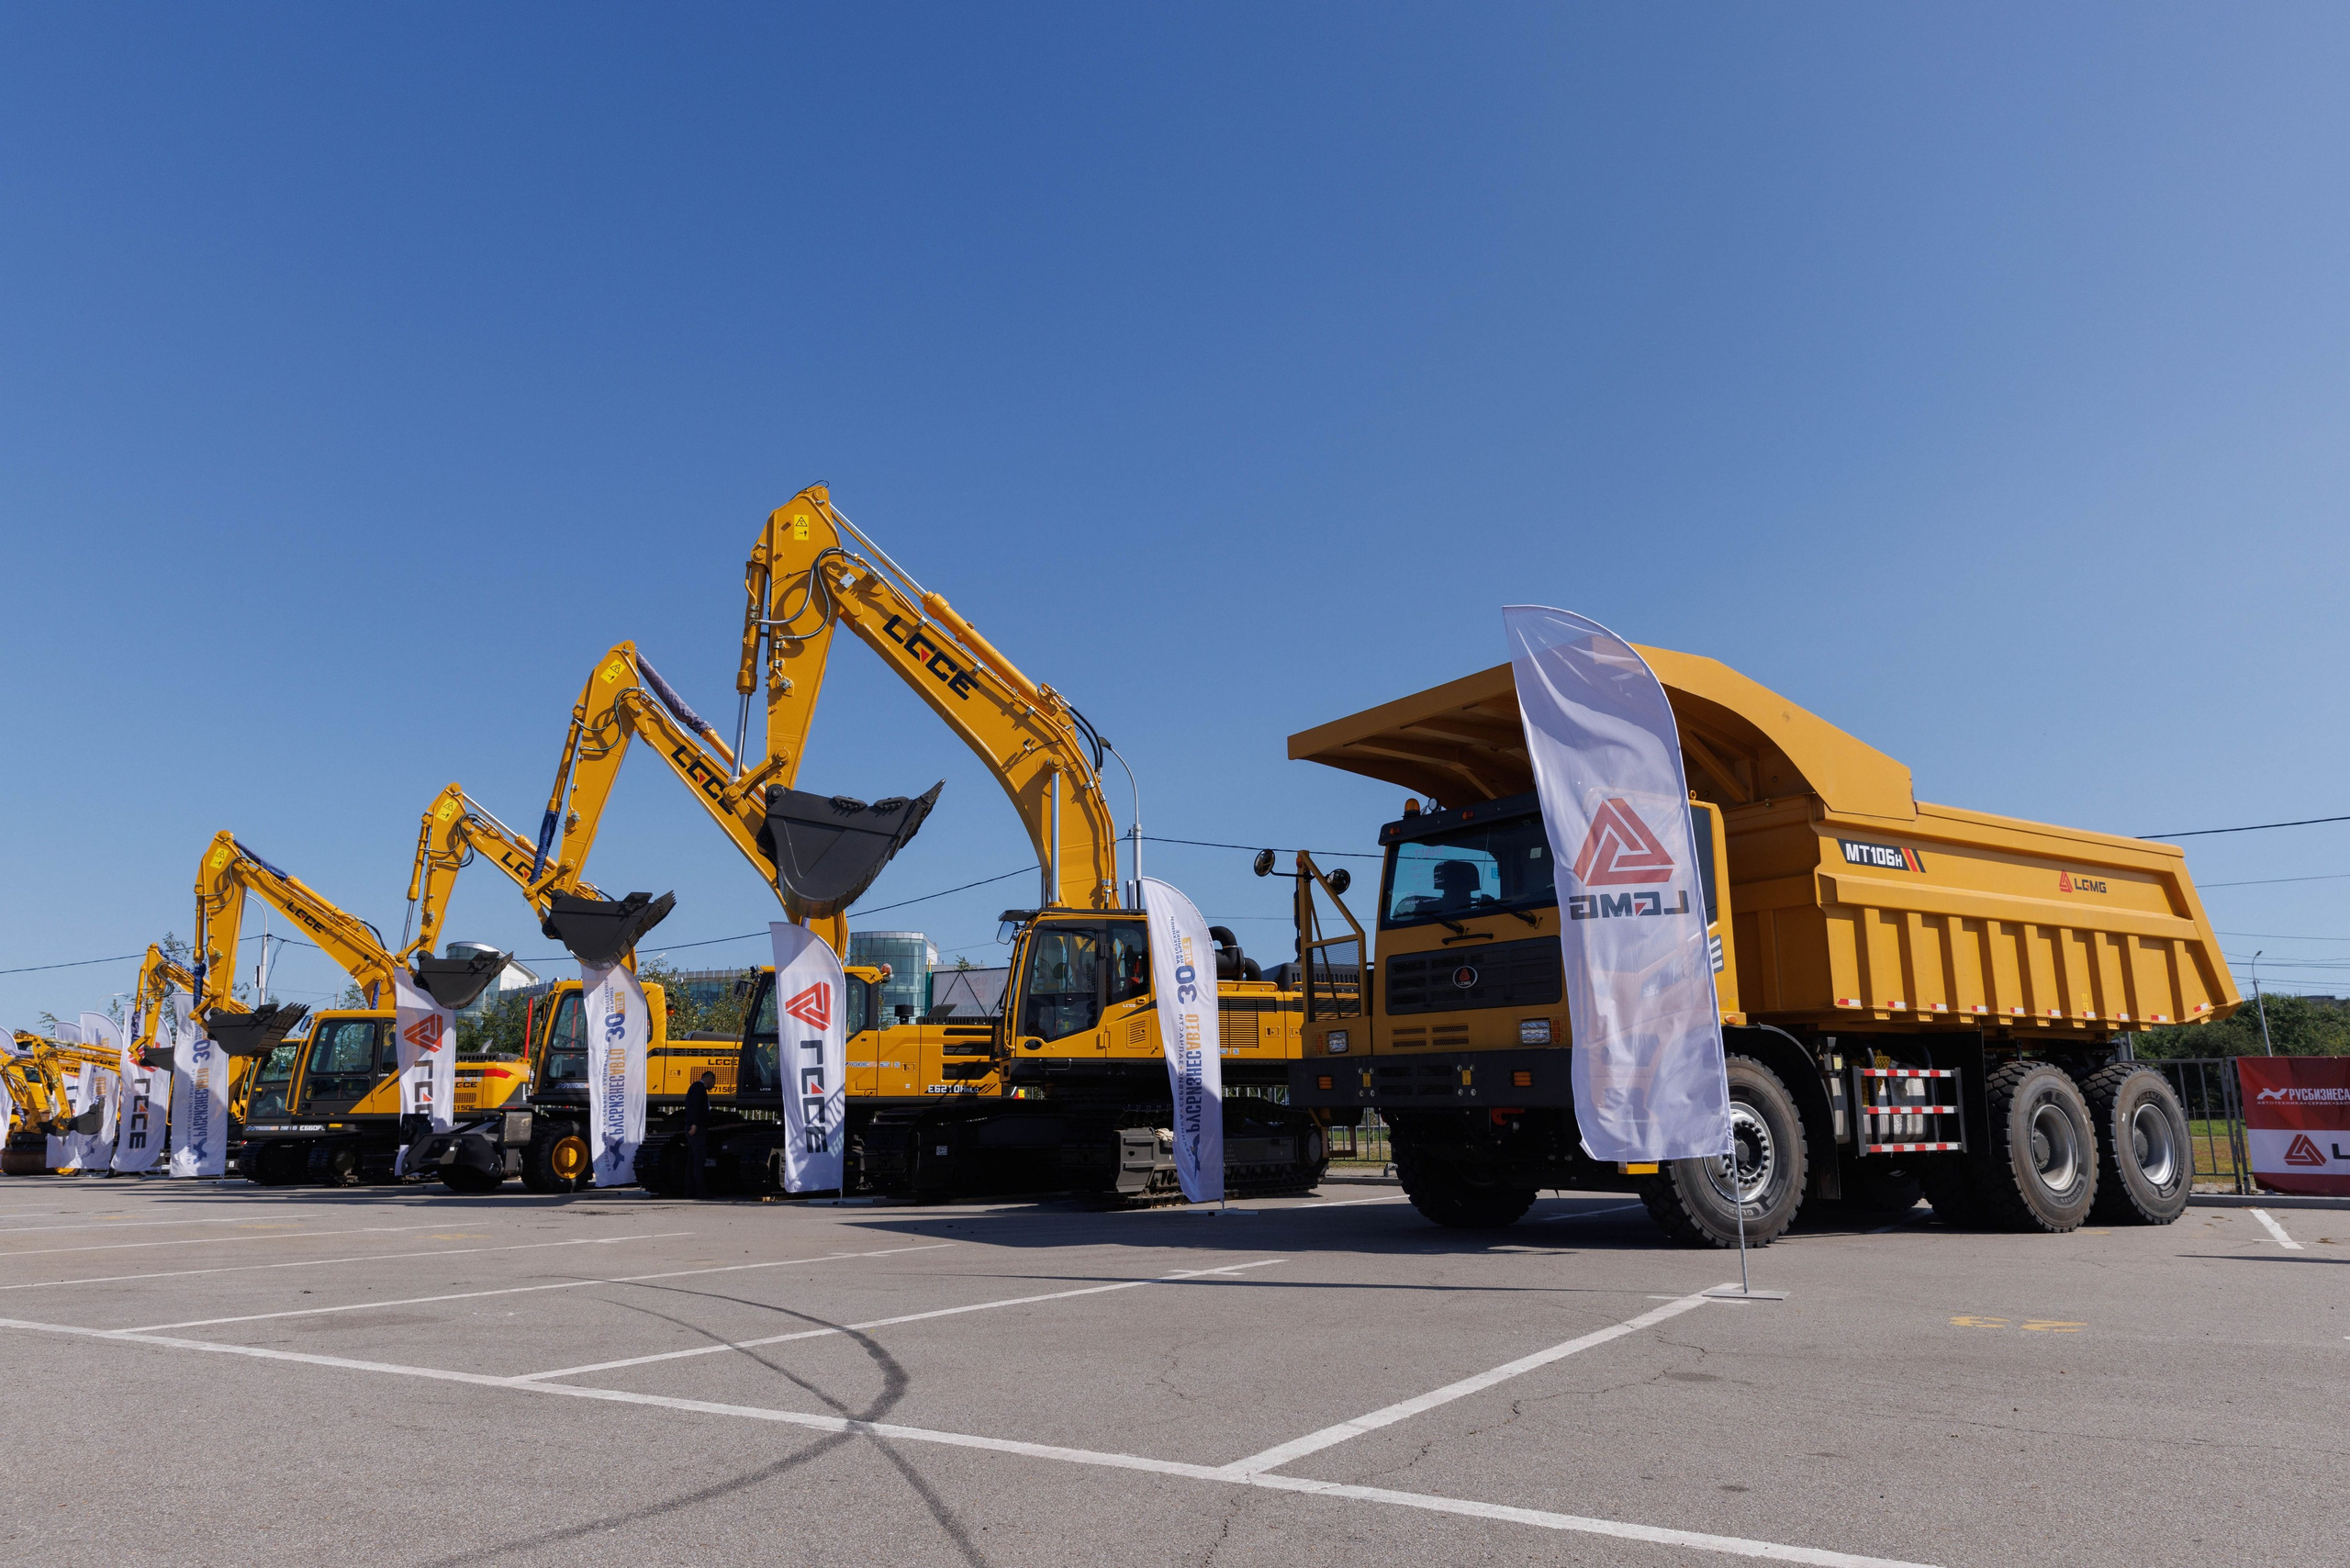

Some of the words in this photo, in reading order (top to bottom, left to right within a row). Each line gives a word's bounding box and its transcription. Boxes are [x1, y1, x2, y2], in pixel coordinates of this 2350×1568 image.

[883, 614, 979, 700] LGCE
[1845, 843, 1903, 868] MT106H
[2074, 878, 2107, 893] LGMG
